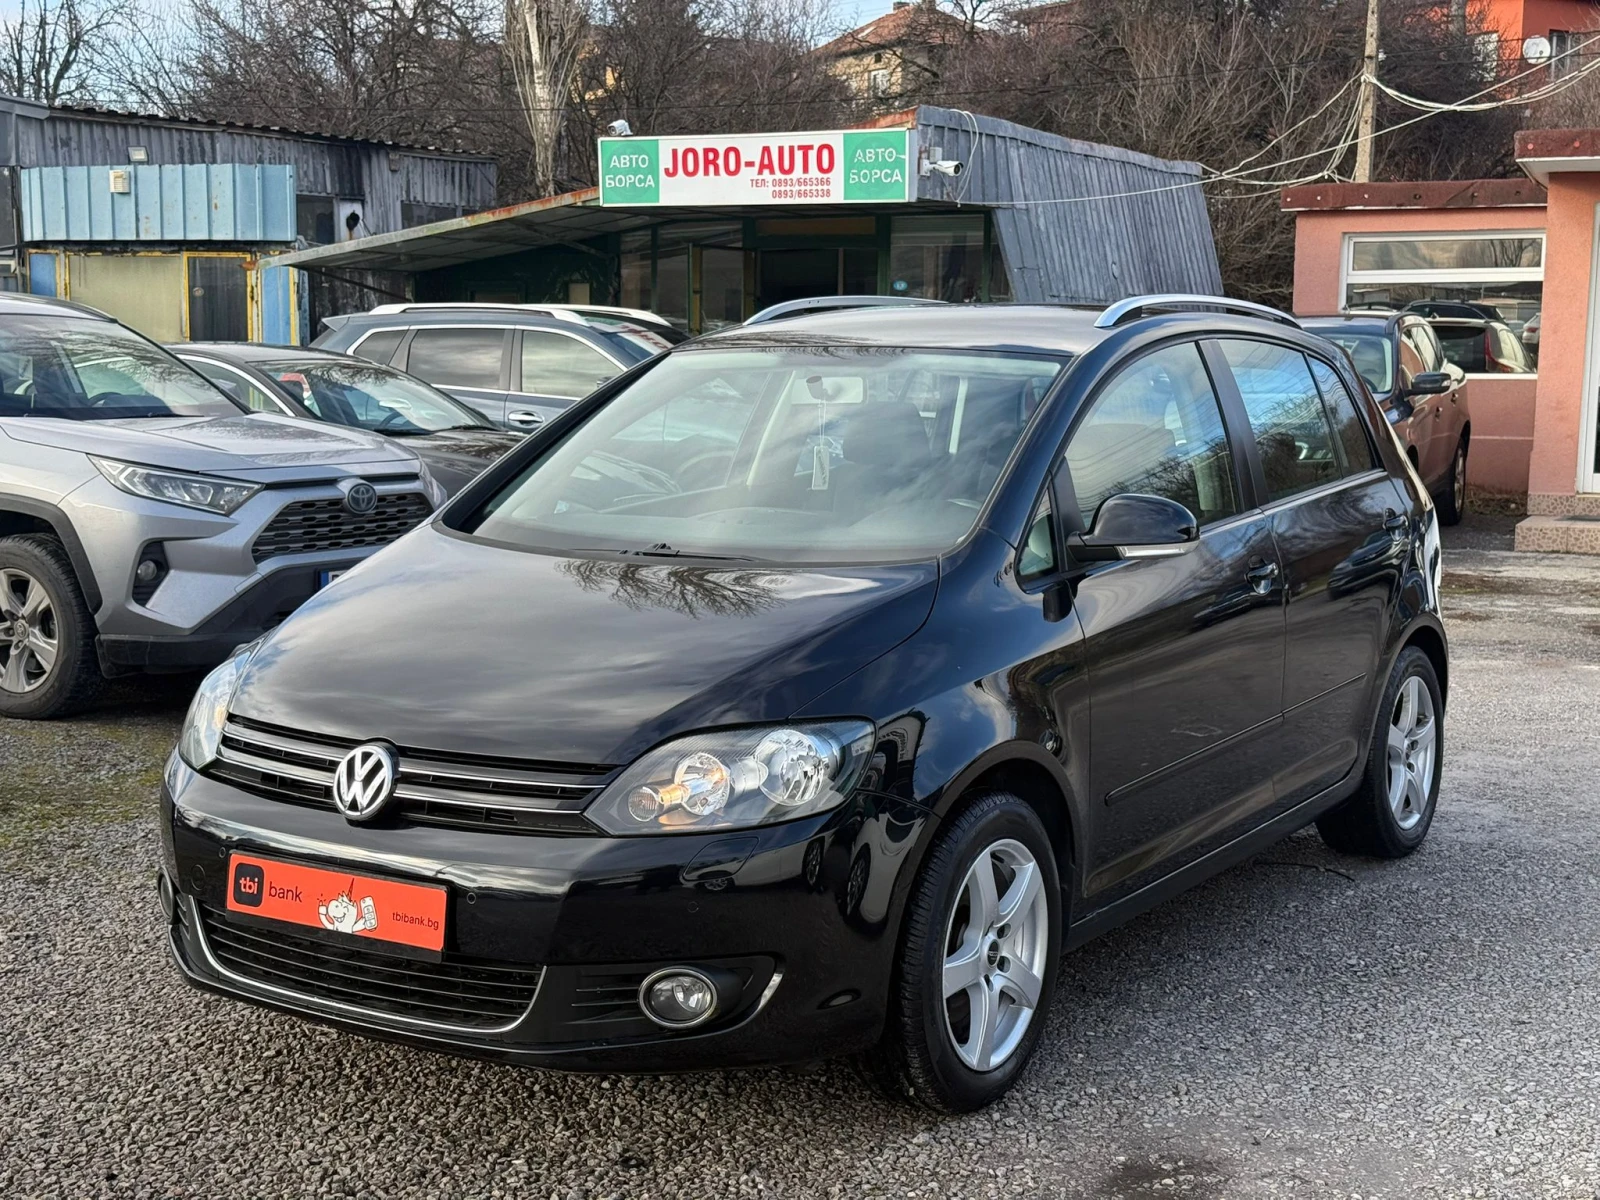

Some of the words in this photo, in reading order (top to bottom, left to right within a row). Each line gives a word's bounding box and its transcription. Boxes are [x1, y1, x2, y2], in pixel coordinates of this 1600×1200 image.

[609, 154, 649, 168] АВТО
[664, 143, 835, 178] JORO-AUTO
[854, 148, 897, 163] АВТО
[605, 174, 655, 188] БОРСА
[771, 177, 831, 188] 0893/665366
[849, 168, 903, 184] БОРСА
[771, 188, 831, 200] 0893/665338
[239, 876, 259, 895] tbi
[268, 880, 303, 903] bank
[392, 911, 440, 931] tbibank.bg
